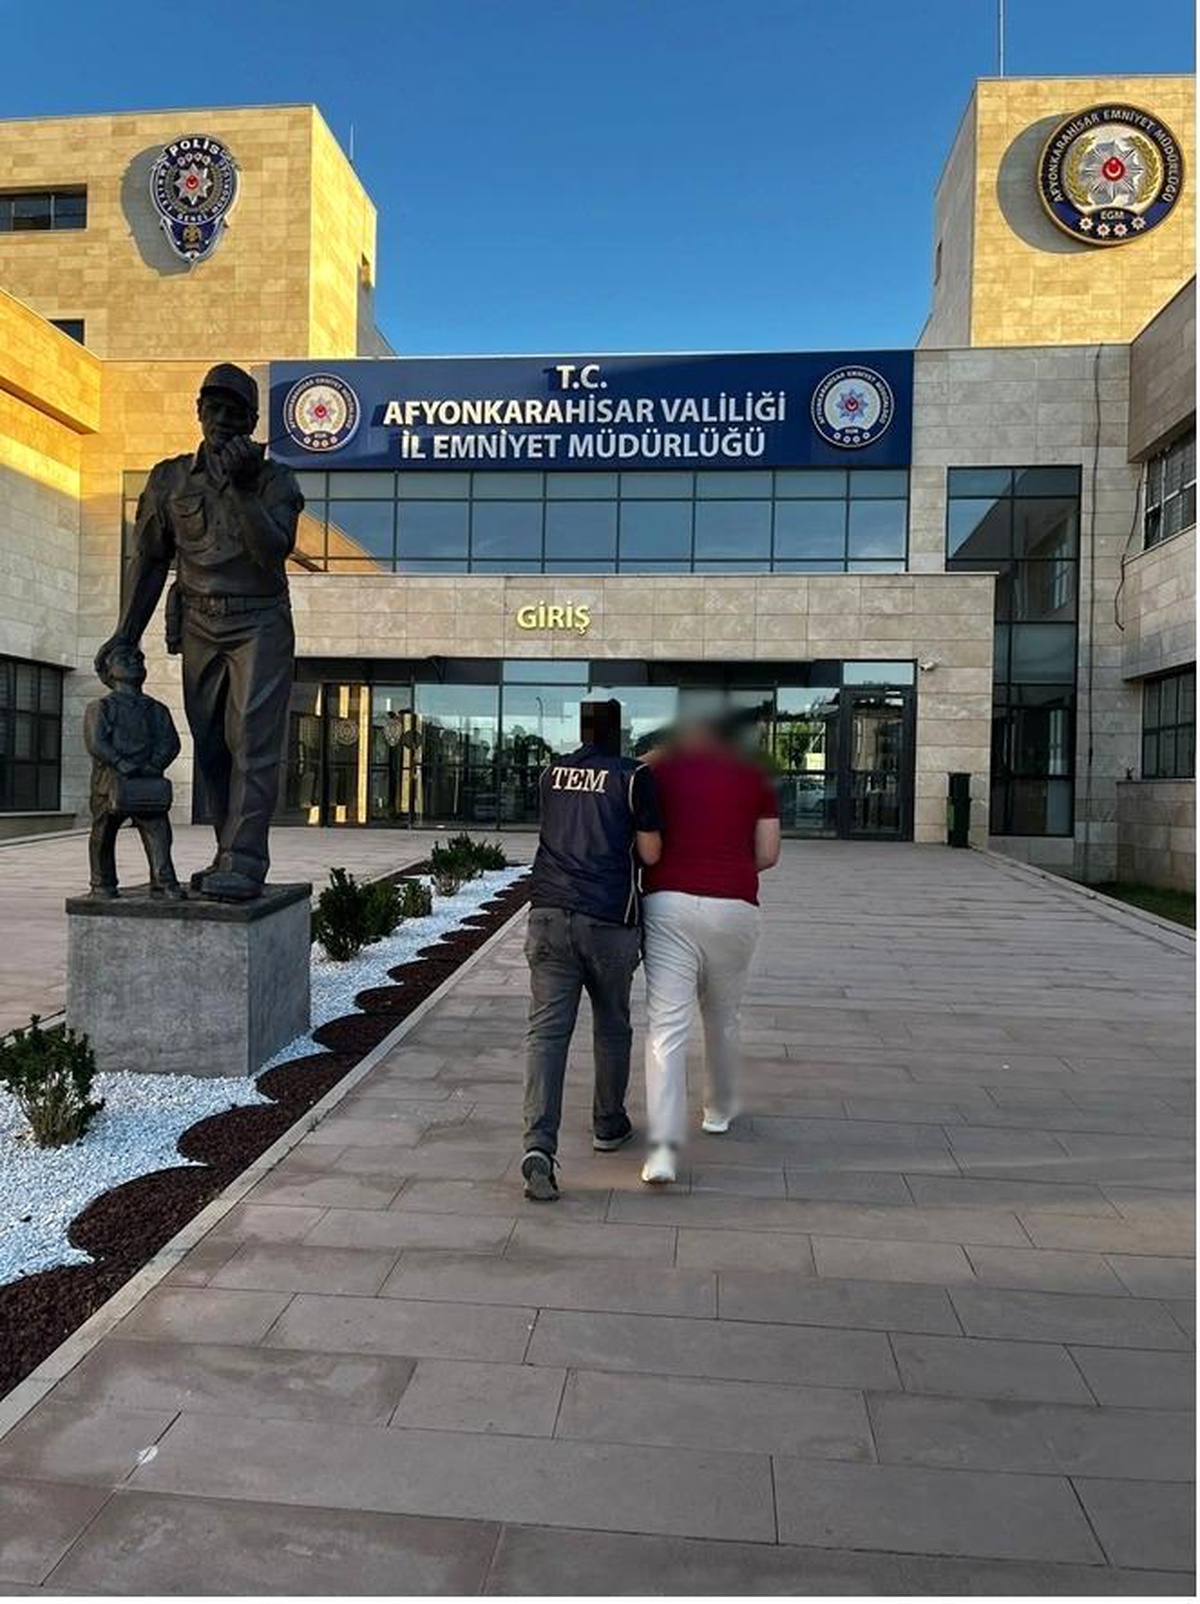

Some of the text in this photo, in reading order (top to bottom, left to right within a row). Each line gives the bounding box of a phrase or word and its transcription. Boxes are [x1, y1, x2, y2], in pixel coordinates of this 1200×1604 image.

[168, 138, 220, 157] POLİS
[1100, 210, 1126, 221] EGM
[556, 365, 607, 389] T.C.
[383, 391, 785, 425] AFYONKARAHİSAR VALİLİĞİ
[402, 426, 765, 459] İL EMNİYET MÜDÜRLÜĞÜ
[517, 600, 591, 634] GİRİŞ
[551, 766, 609, 793] TEM
